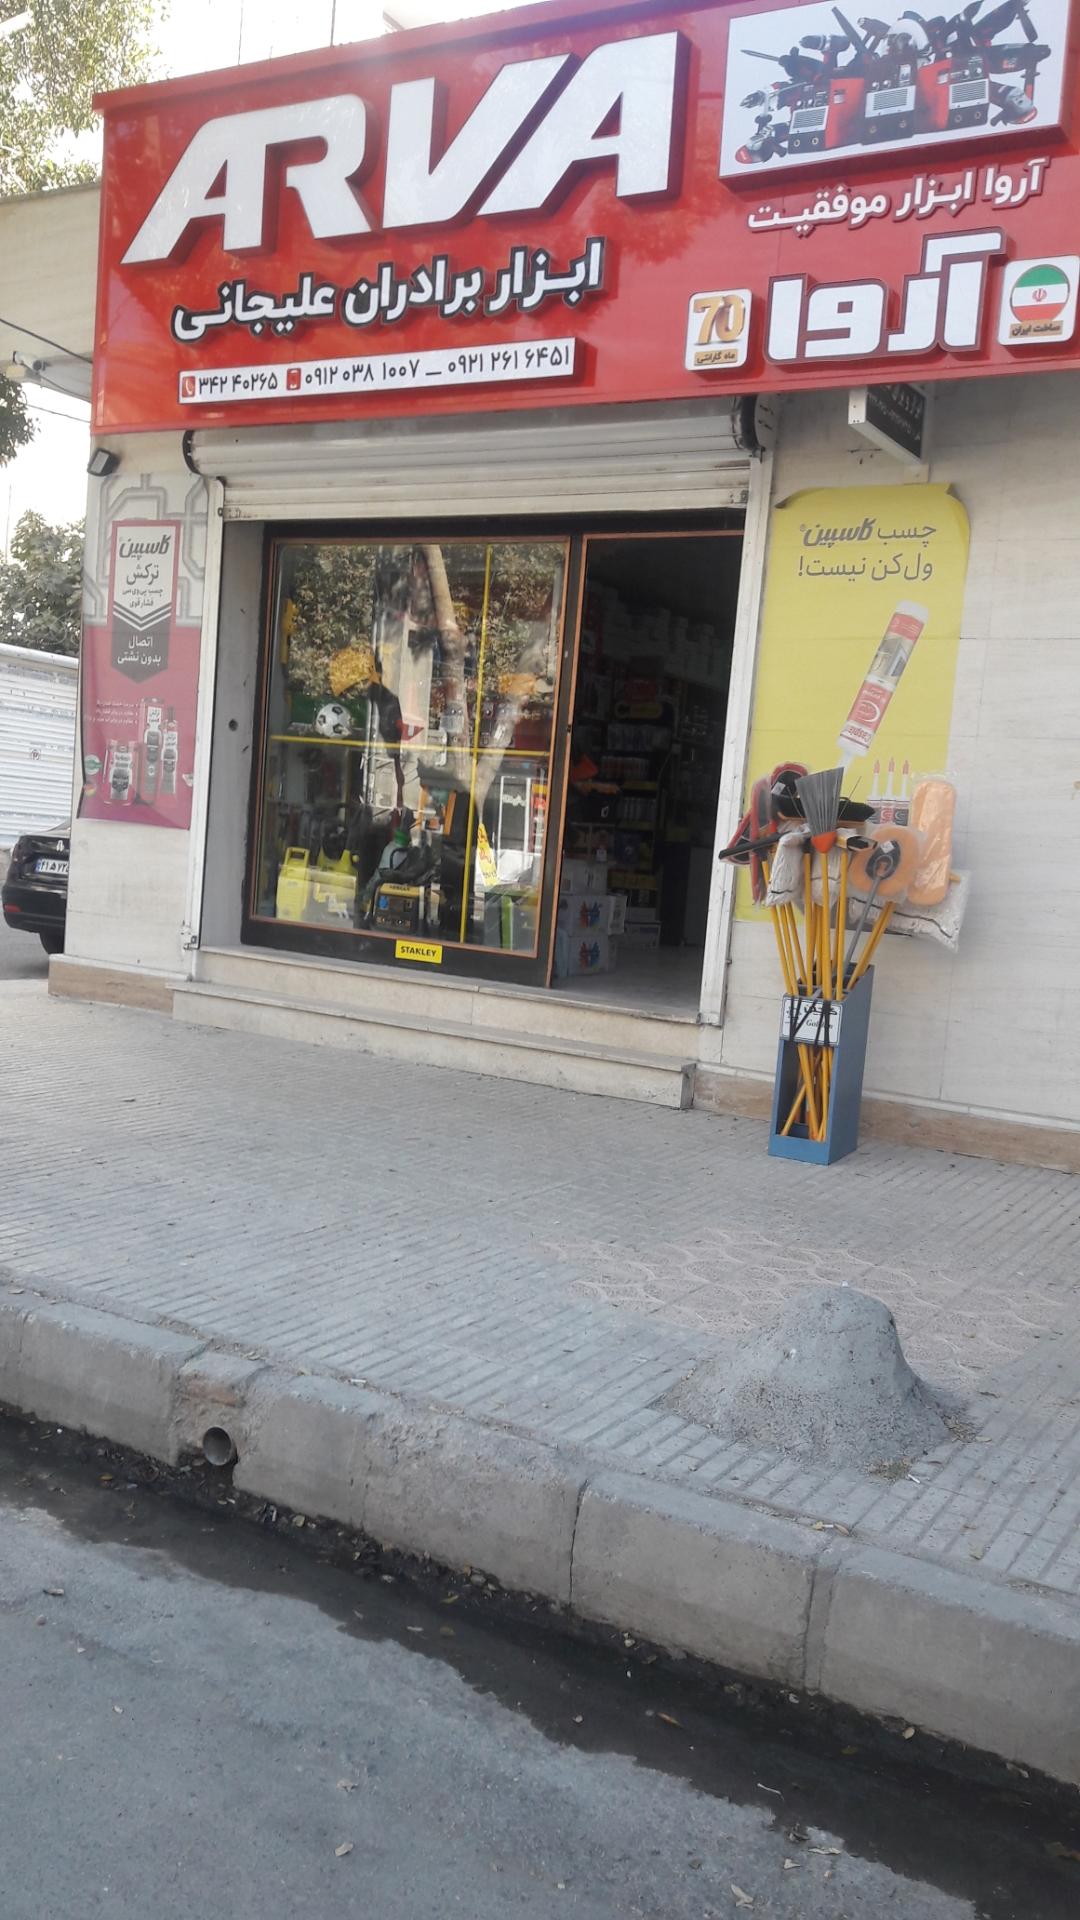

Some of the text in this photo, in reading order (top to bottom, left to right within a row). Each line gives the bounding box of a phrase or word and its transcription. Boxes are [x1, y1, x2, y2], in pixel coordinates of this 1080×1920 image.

[120, 30, 678, 266] ARVA
[747, 157, 1047, 233] آروا ابزار موفقیت
[174, 241, 602, 341] ابزار برادران علیجانی
[769, 231, 1002, 361] آروا
[693, 294, 746, 346] 70
[1011, 325, 1032, 337] ایران
[118, 533, 172, 561] کاسپین
[876, 524, 938, 548] چسب
[126, 563, 160, 586] ترکش
[128, 634, 154, 650] اتصال
[117, 650, 162, 668] بدون نشتی
[400, 945, 437, 957] STANLEY
